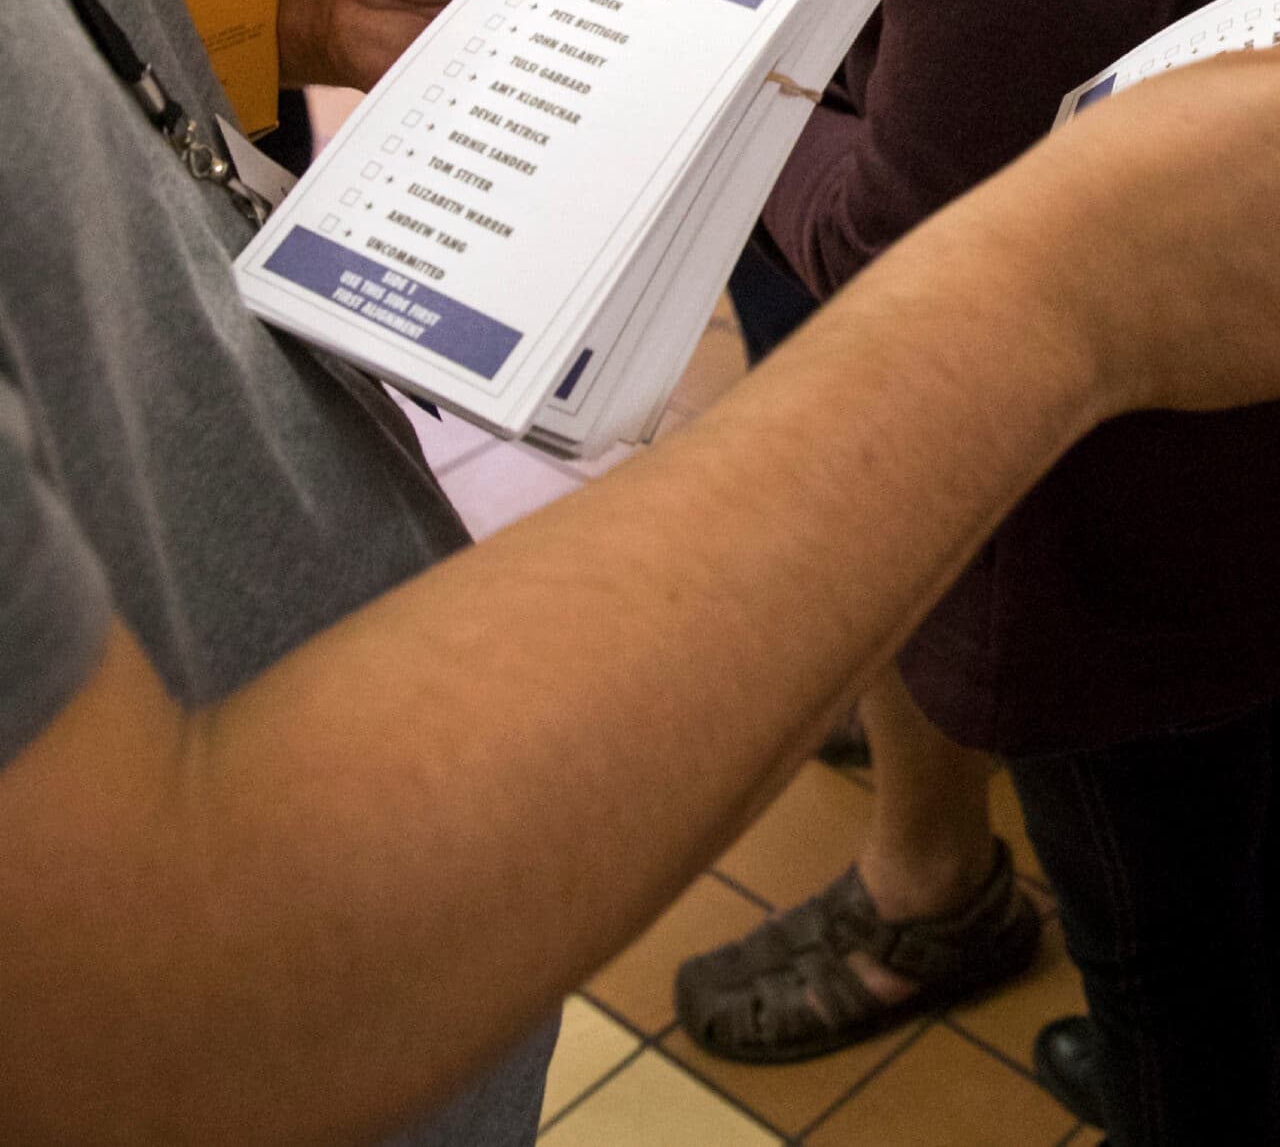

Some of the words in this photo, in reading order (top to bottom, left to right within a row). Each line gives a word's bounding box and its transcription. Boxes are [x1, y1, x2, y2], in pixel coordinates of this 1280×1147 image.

[549, 9, 575, 25] PETE
[574, 18, 629, 44] BUTTIGIEG
[529, 33, 559, 49] JOHN
[559, 43, 606, 66] DELANEY
[510, 55, 539, 73] TULSI
[539, 68, 591, 95] GABBARD
[490, 81, 516, 96] AMY
[517, 91, 581, 124] KLOBUCHAR
[469, 105, 503, 126] DEVAL
[504, 119, 549, 146] PATRICK
[448, 130, 487, 154] BERNIE
[489, 148, 537, 175] SANDERS
[429, 156, 454, 174] TOM
[454, 168, 493, 192] STEYER
[407, 183, 464, 214] ELIZABETH
[465, 209, 513, 237] WARREN
[387, 210, 434, 237] ANDREW
[437, 232, 467, 253] YANG
[366, 238, 445, 280] UNCOMMITTED
